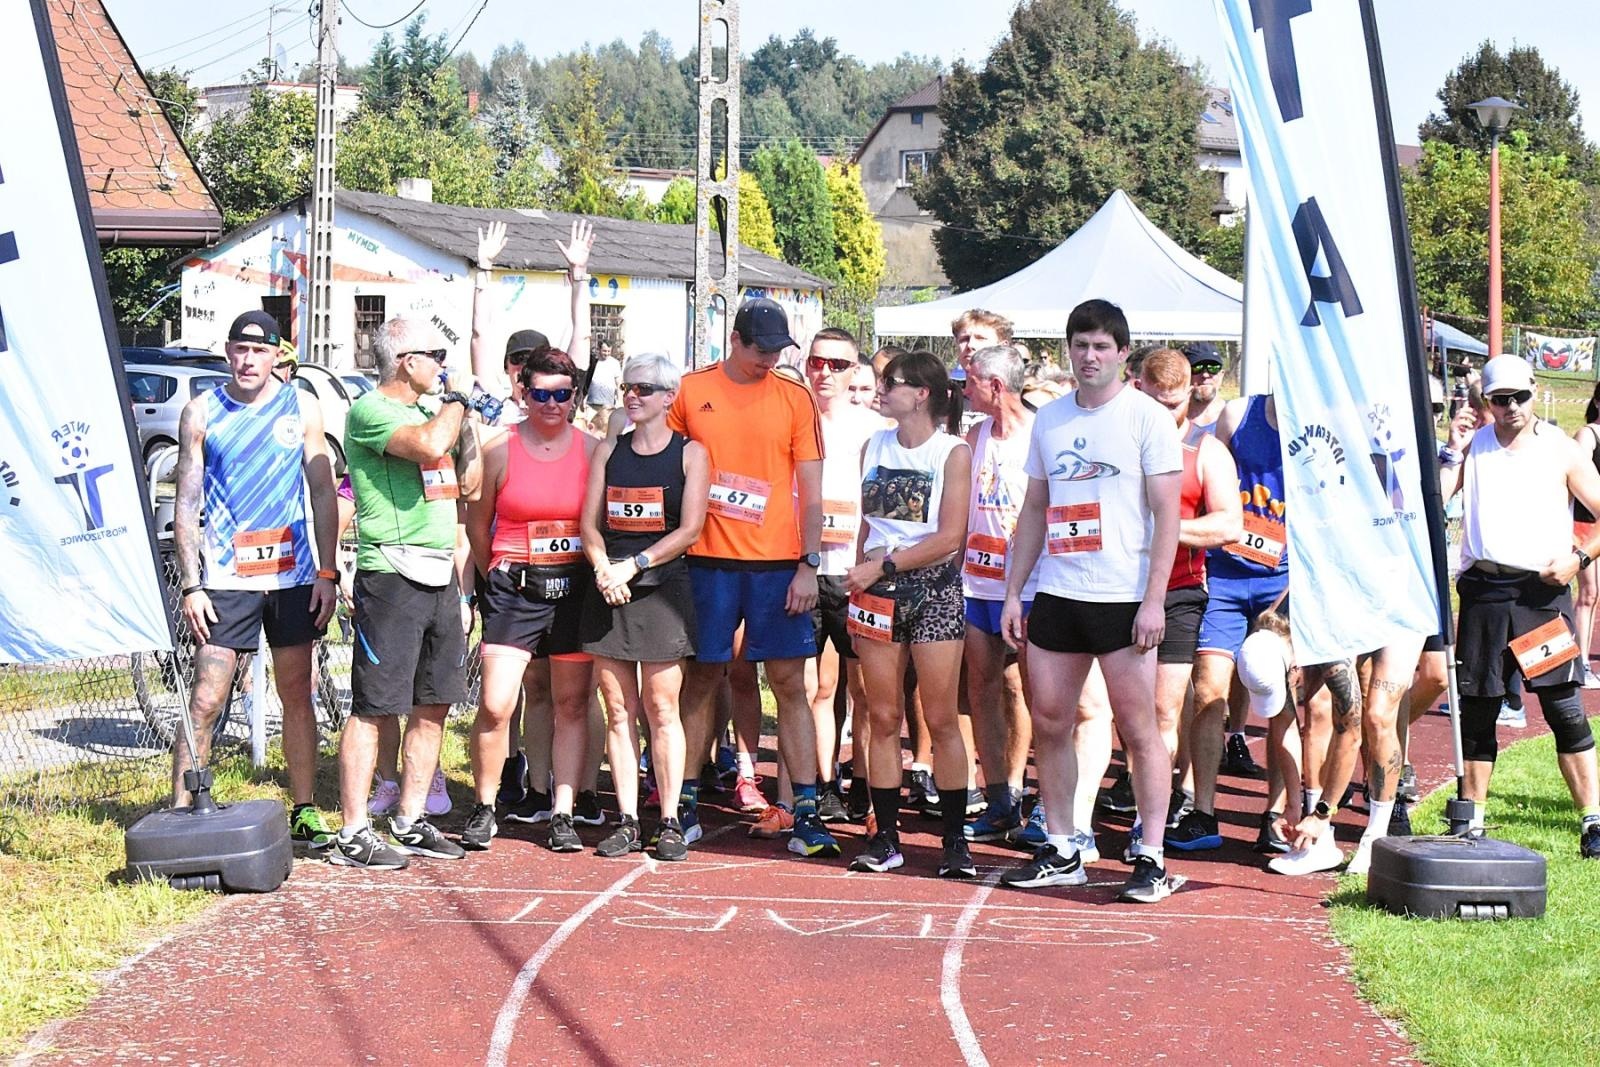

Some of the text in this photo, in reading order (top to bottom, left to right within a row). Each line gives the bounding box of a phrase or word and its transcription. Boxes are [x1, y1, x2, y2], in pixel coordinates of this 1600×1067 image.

[347, 231, 380, 254] MYMEK
[430, 314, 460, 346] MYMEK
[438, 470, 445, 483] 1
[727, 490, 749, 506] 67
[623, 504, 644, 517] 59
[1069, 522, 1078, 537] 3
[549, 538, 571, 552] 60
[1244, 533, 1264, 549] 10
[256, 546, 274, 560] 17
[977, 551, 991, 566] 72
[857, 609, 876, 627] 44
[1540, 644, 1553, 658] 2
